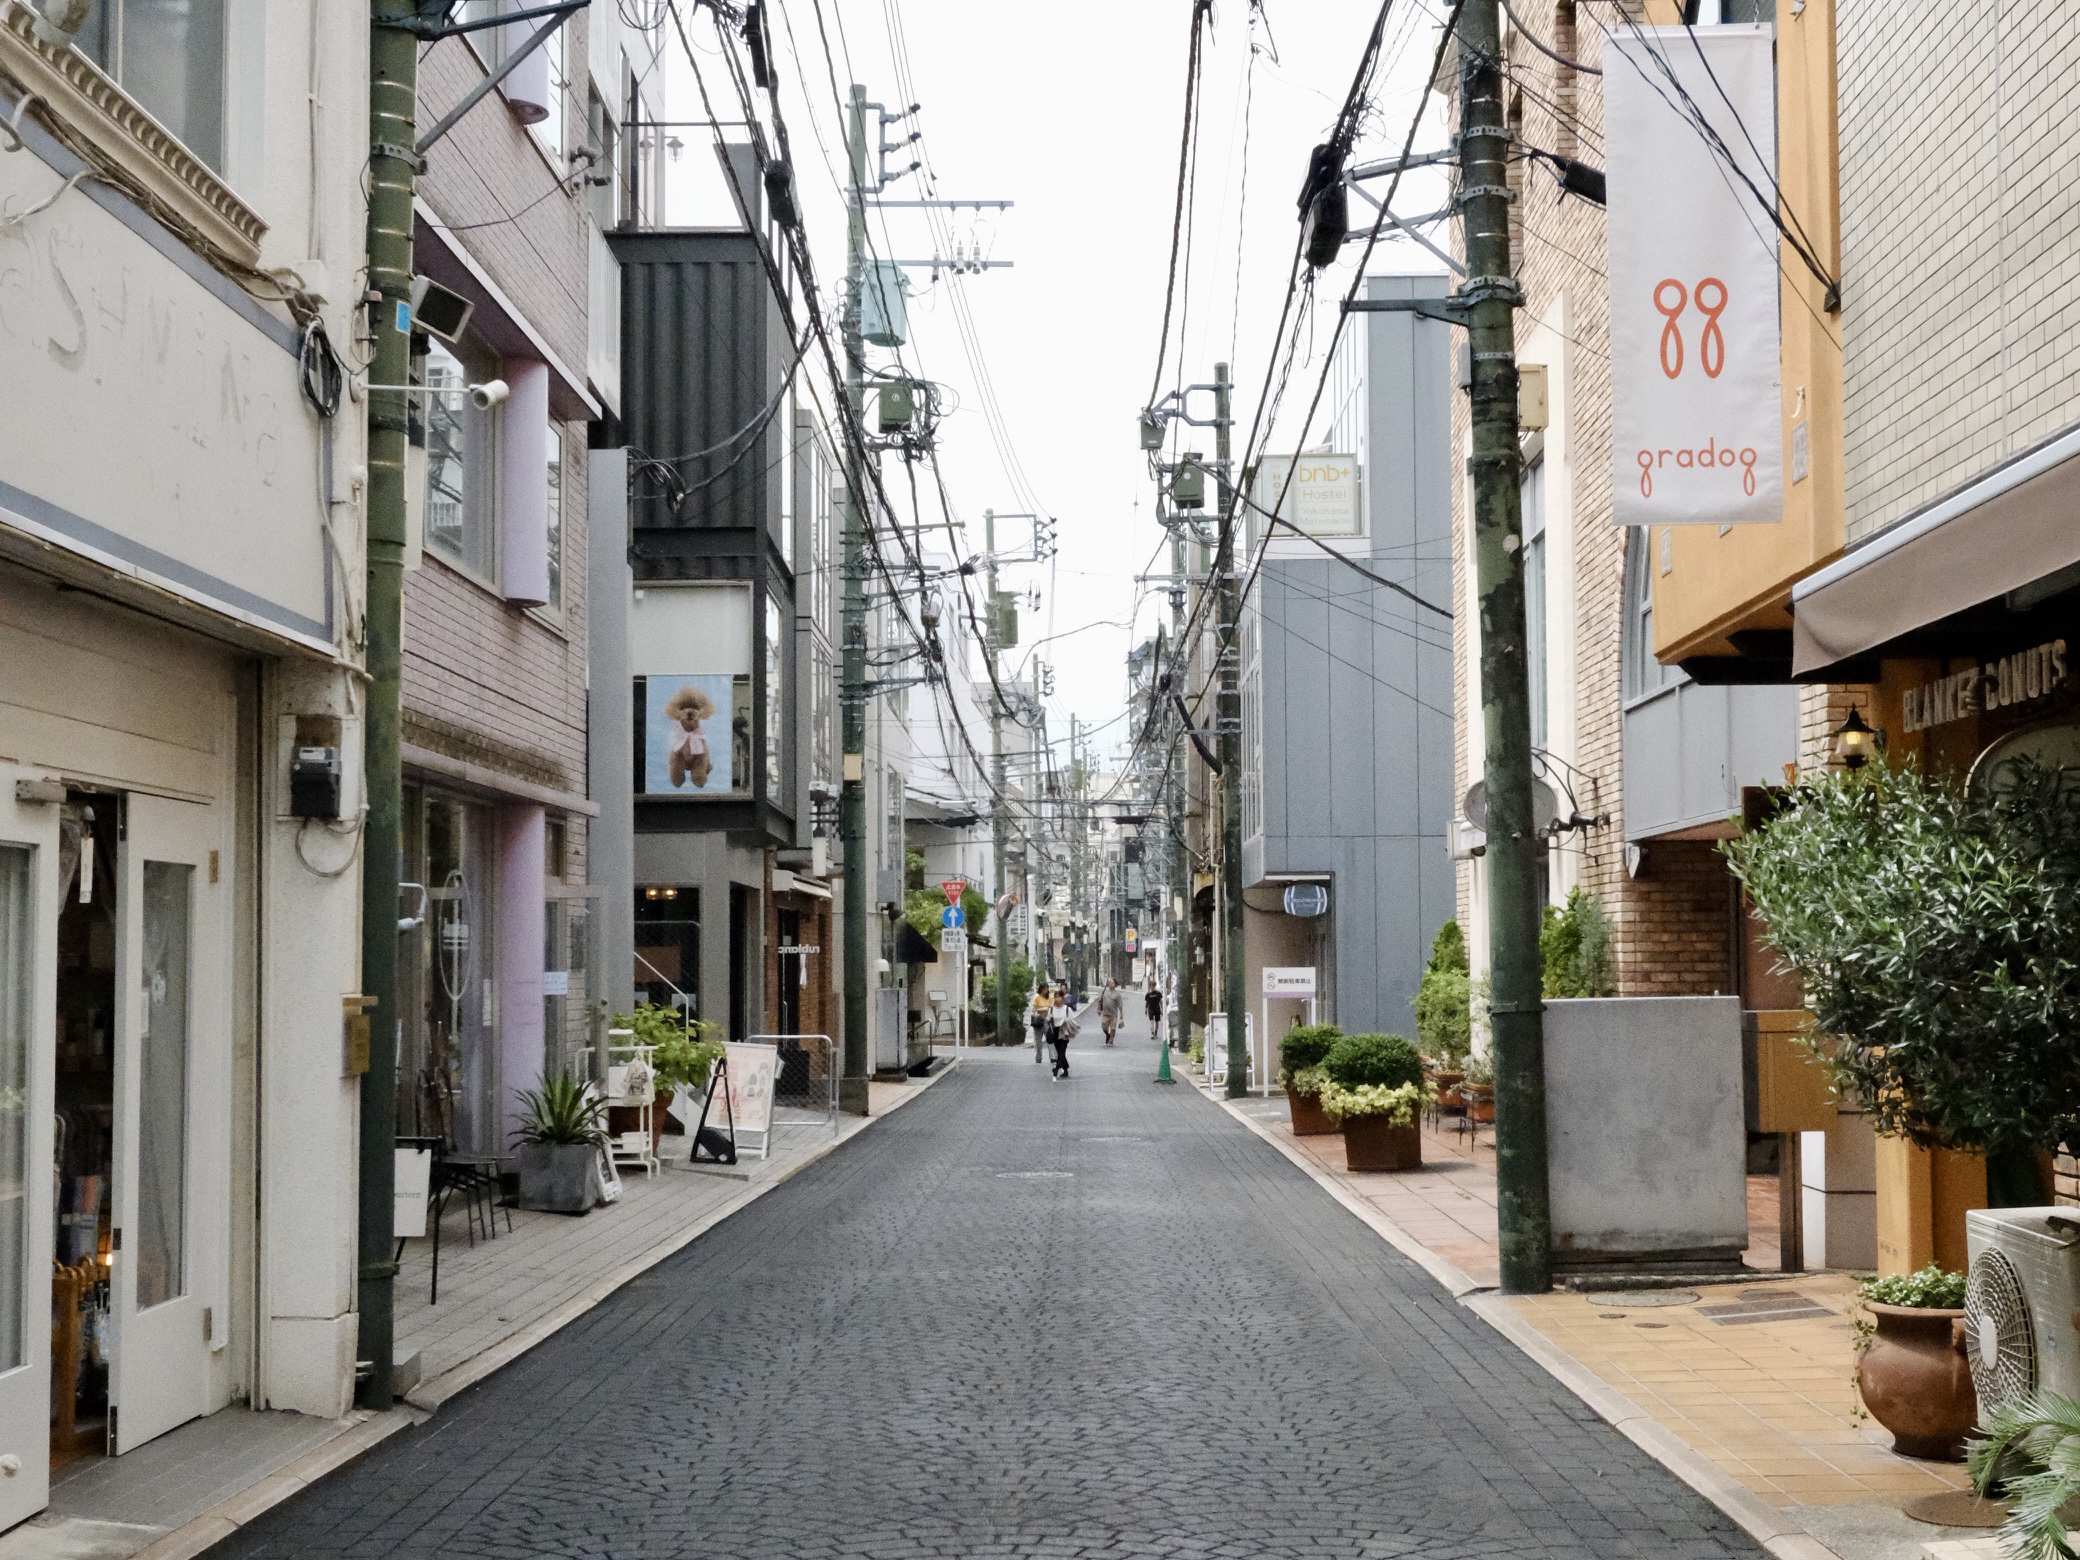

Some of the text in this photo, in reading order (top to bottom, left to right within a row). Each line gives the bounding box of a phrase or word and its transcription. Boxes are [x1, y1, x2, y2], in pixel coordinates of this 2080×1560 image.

[1299, 464, 1350, 483] bnb+
[1637, 437, 1757, 498] gradog
[1302, 488, 1347, 500] Hostel
[1302, 506, 1350, 515] Yokohama
[1301, 518, 1351, 526] Motomachi
[1985, 638, 2067, 711] DONUTS
